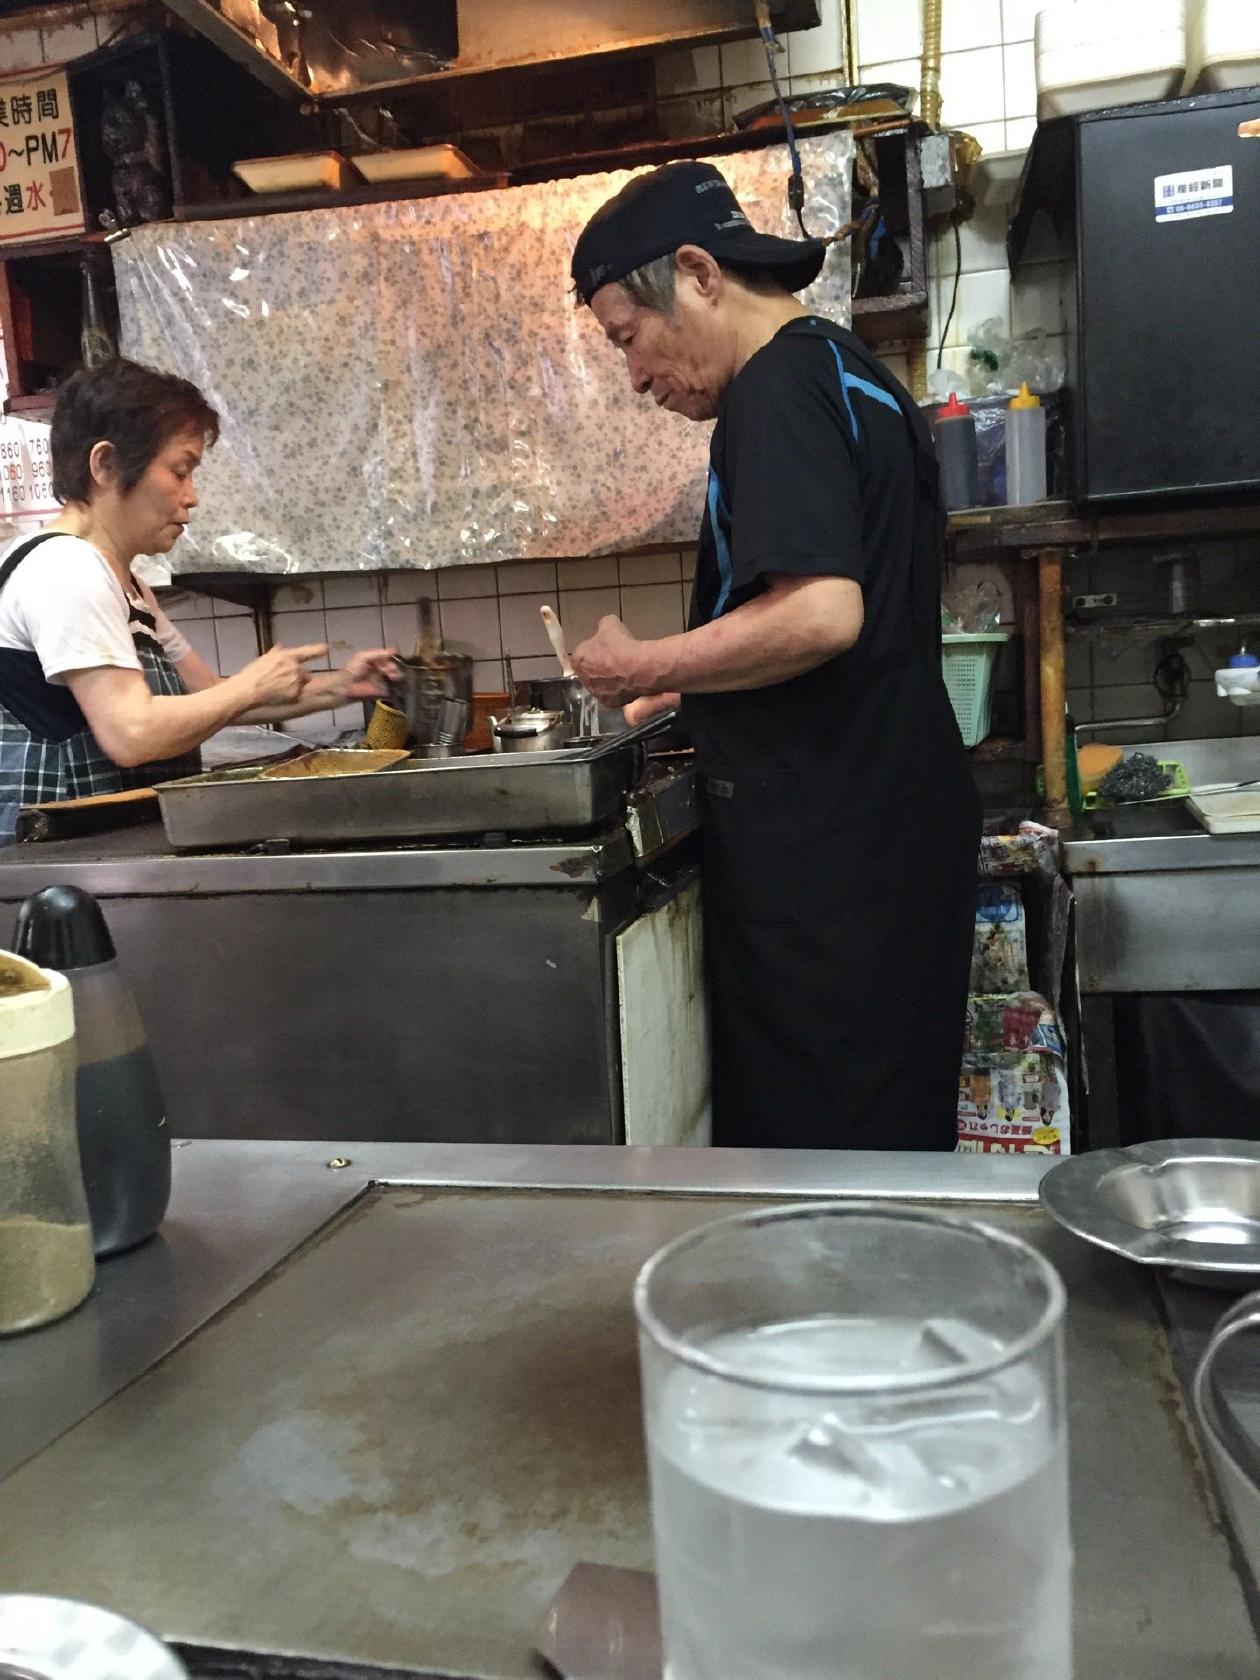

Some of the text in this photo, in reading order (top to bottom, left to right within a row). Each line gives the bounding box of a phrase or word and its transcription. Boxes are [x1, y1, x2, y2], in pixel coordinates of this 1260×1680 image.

[0, 180, 47, 216] 週水
[0, 437, 49, 459] 860 760
[0, 463, 23, 481] 060
